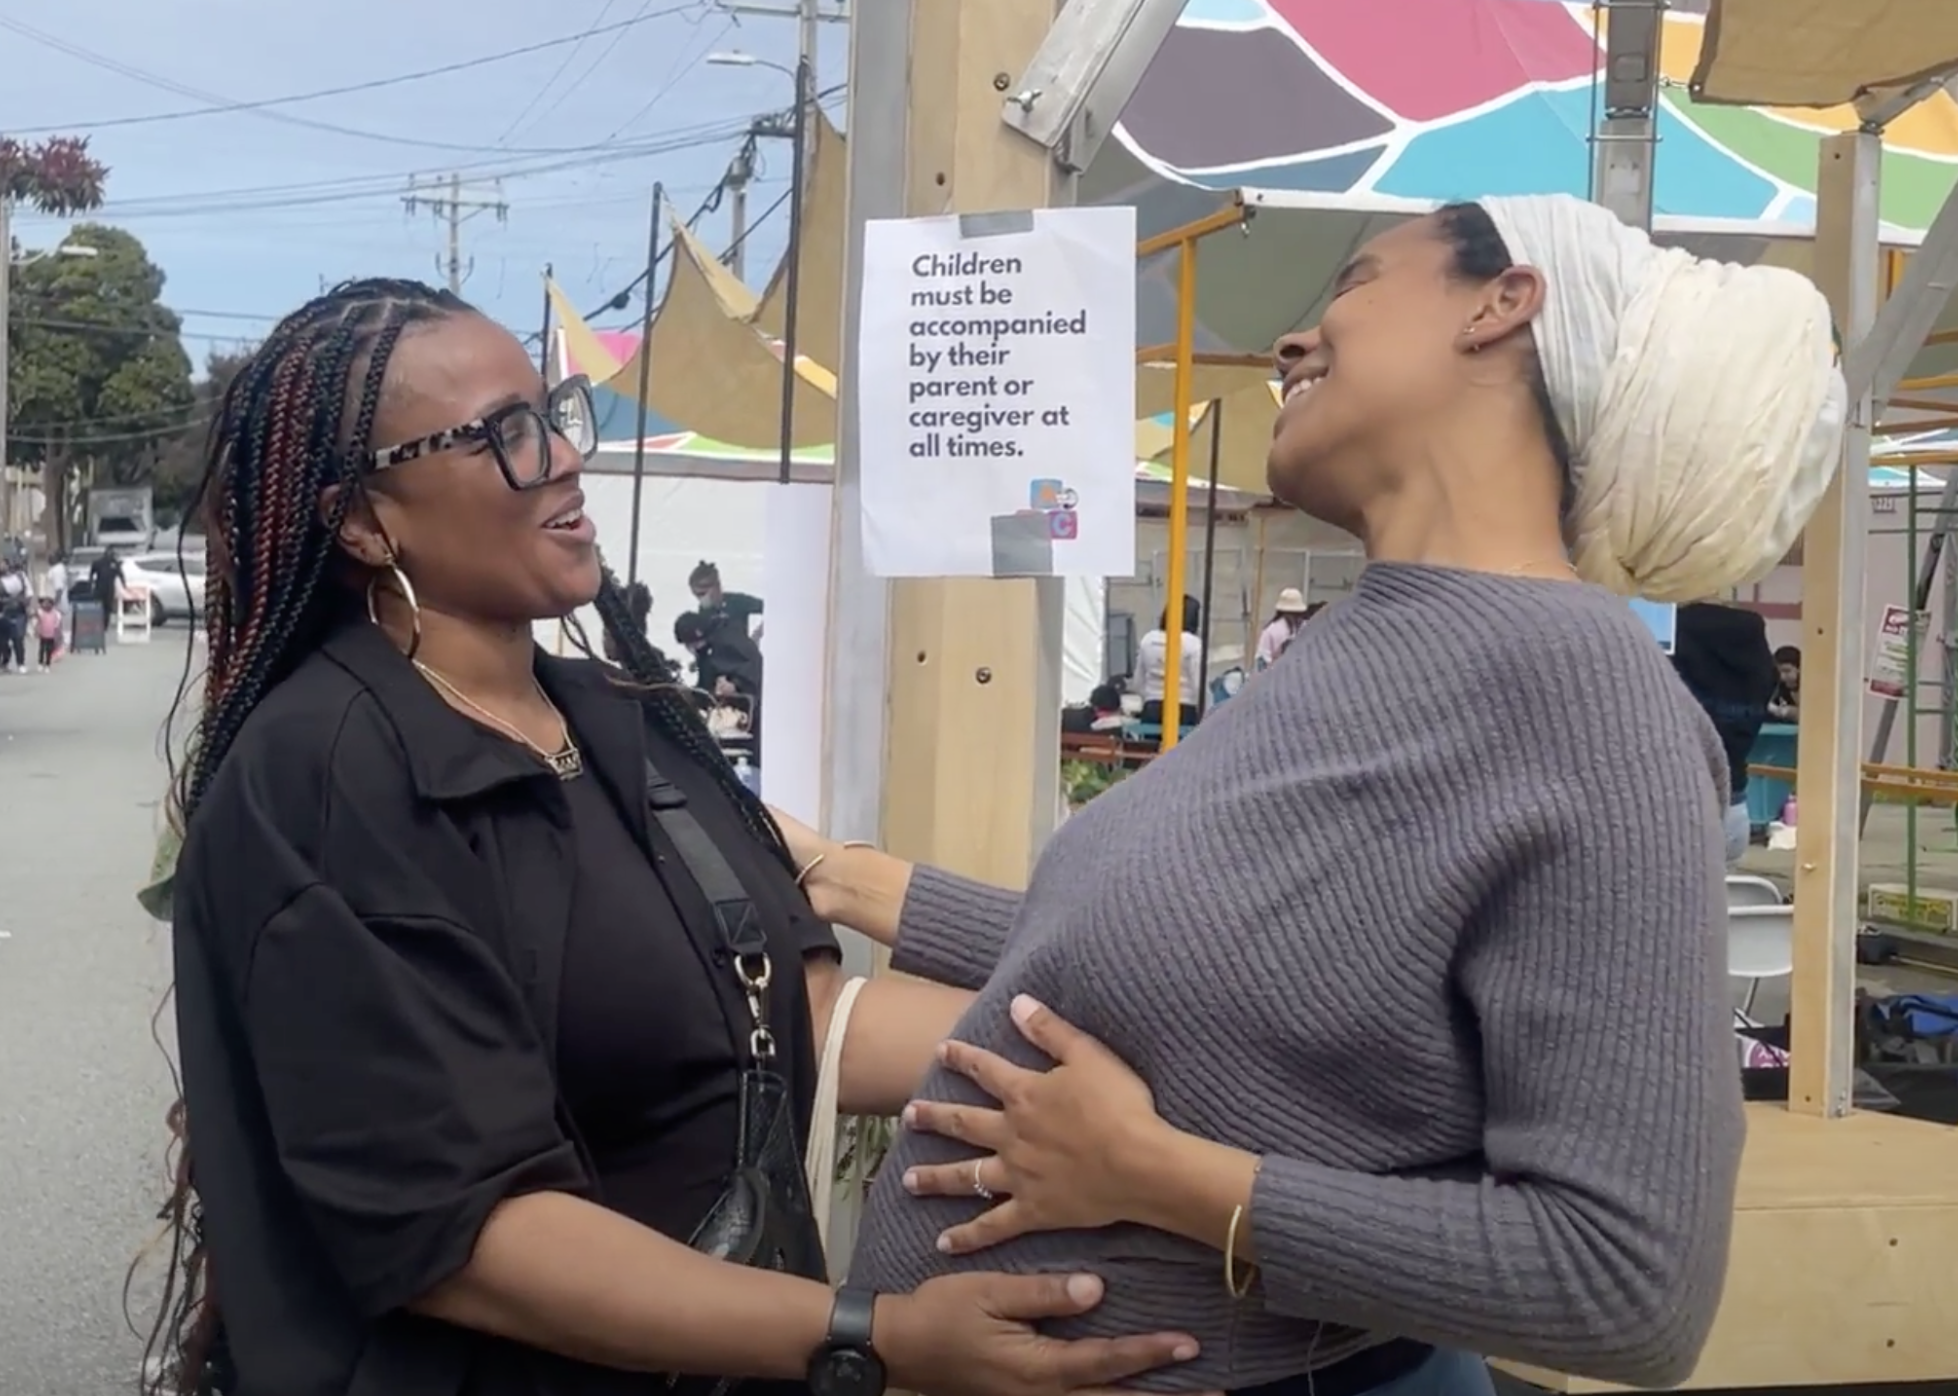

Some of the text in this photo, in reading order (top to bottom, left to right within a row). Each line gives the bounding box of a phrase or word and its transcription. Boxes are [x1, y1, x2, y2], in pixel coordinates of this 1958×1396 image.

[912, 252, 1022, 277] Children
[911, 281, 1012, 306] must be
[909, 310, 1086, 340] accompanied
[909, 343, 1010, 373] by their
[909, 376, 1034, 403] parent or
[909, 404, 1069, 432] caregiver at
[909, 434, 1023, 457] all times.
